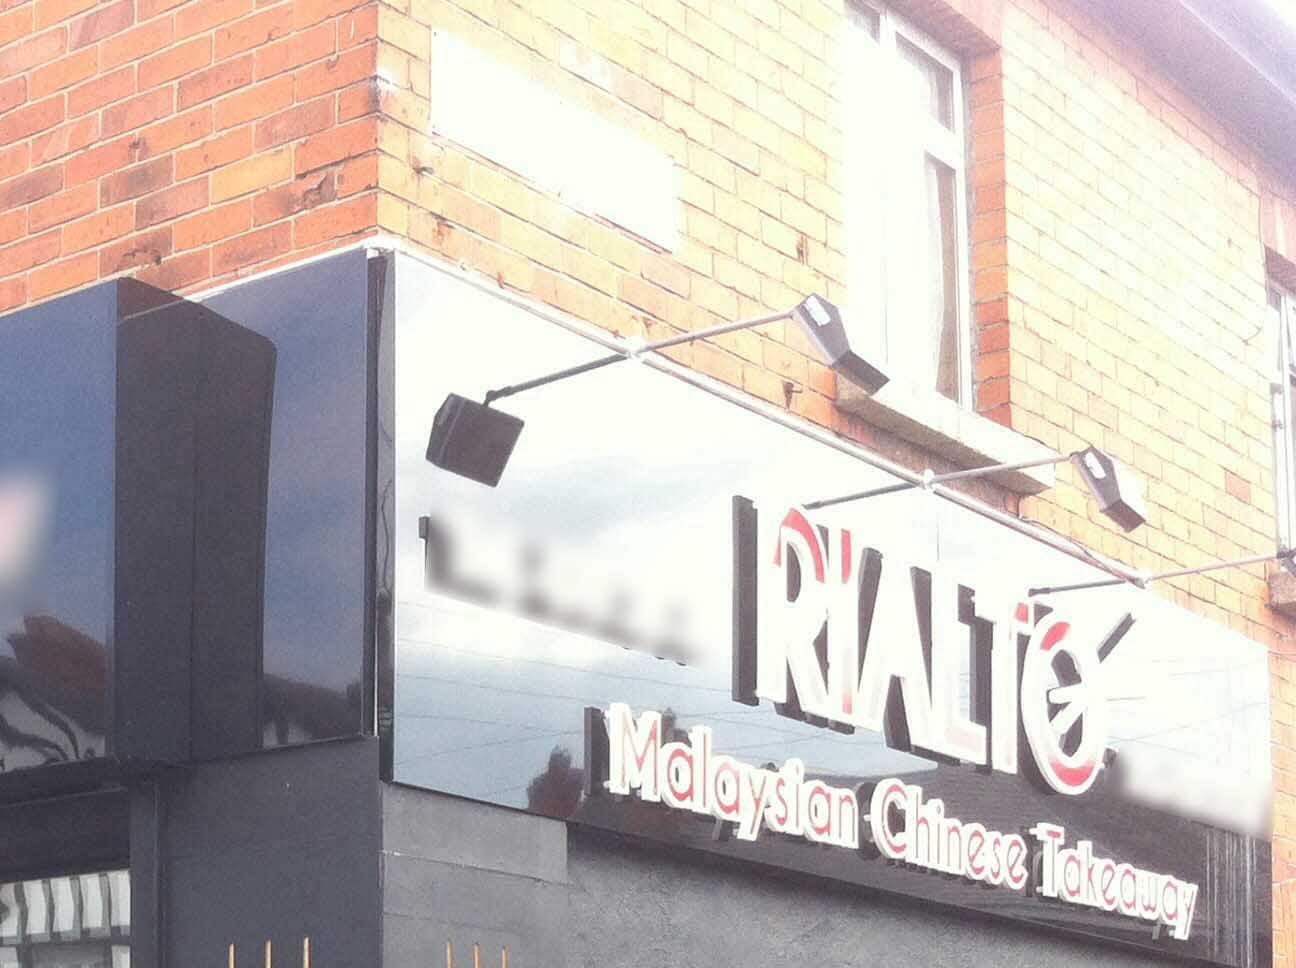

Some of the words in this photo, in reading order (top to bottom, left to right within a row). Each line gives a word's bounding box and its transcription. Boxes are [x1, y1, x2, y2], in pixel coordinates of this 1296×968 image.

[734, 495, 1108, 796] RIALTO
[586, 702, 860, 848] Malaysian
[869, 777, 1029, 890] Chinese
[1029, 820, 1200, 941] Takeaway
